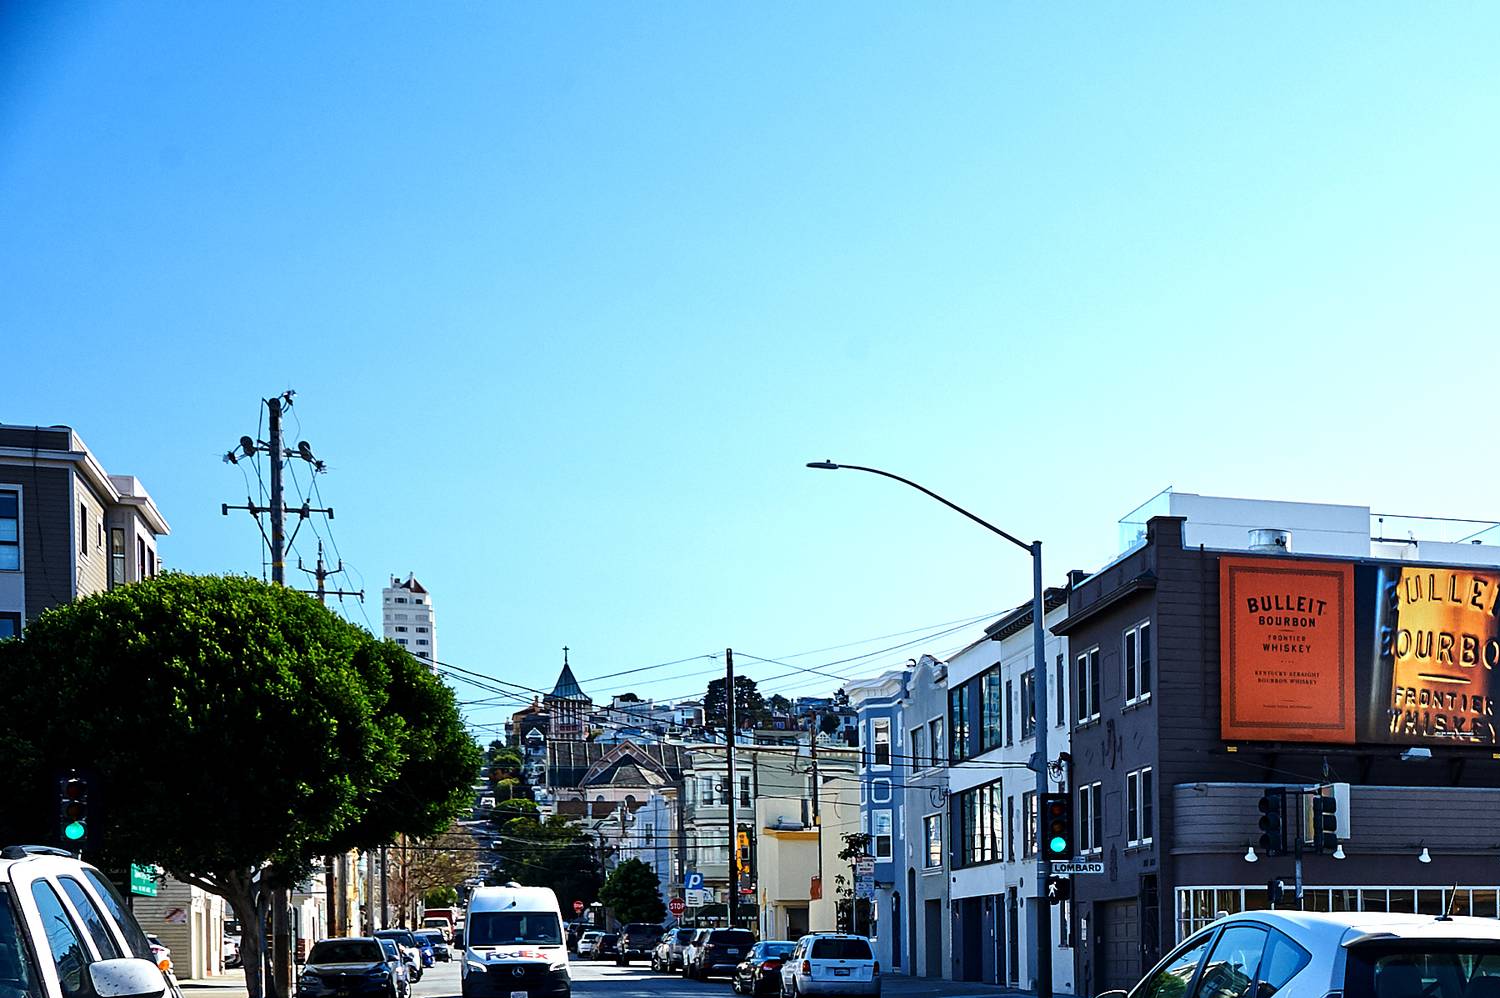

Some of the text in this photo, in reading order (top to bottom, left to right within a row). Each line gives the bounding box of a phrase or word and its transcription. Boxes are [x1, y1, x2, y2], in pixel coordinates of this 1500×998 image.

[1247, 595, 1327, 617] BULLEIT
[1258, 615, 1316, 628] BOURBON
[1267, 634, 1306, 642] FRONTIER
[1262, 643, 1312, 654] WHISKEY
[1395, 686, 1494, 716] FRONTIER
[1054, 864, 1102, 872] LOMBARD
[669, 902, 685, 910] STOP
[485, 950, 549, 961] FedEx
